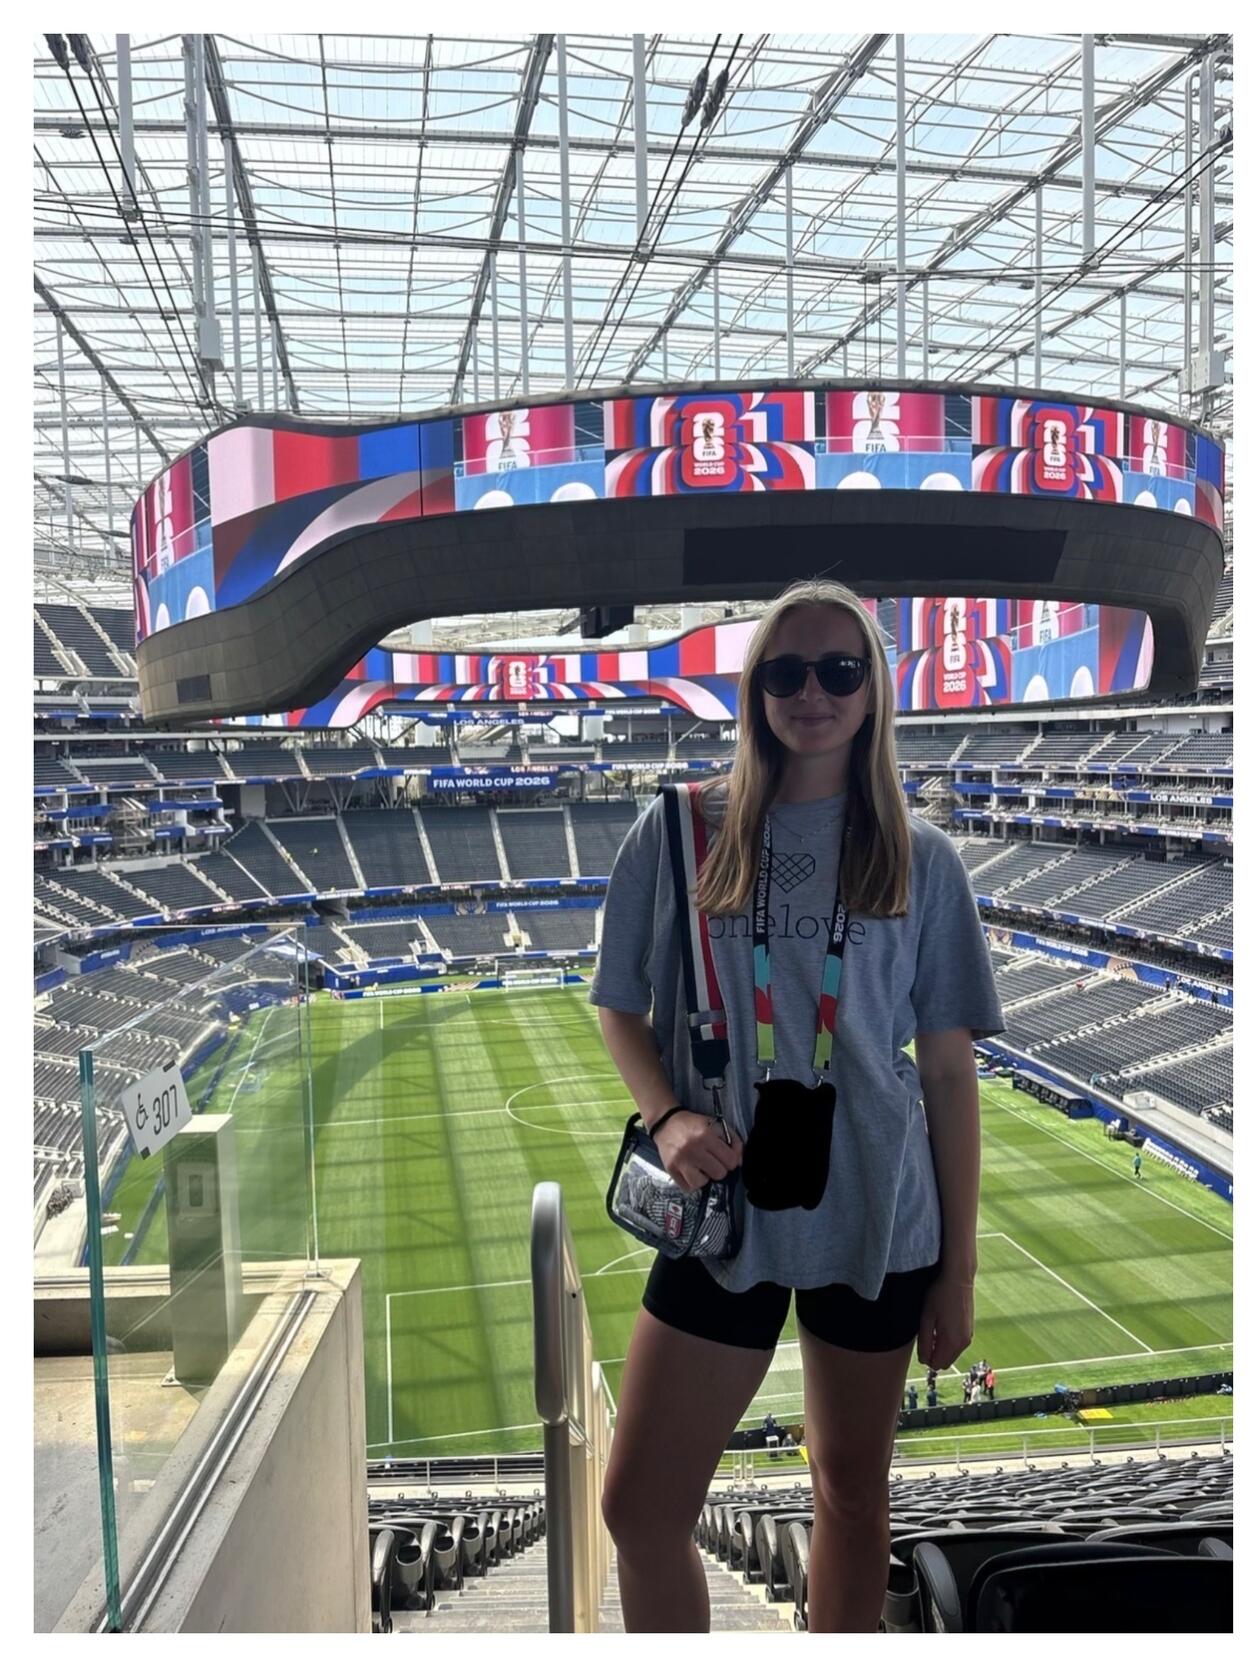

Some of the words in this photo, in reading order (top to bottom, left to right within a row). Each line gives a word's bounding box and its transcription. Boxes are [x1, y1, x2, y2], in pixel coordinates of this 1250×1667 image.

[693, 467, 725, 475] 2026
[433, 779, 455, 788] FIFA
[456, 779, 491, 788] WORLD
[494, 778, 514, 787] CUP
[515, 777, 550, 786] 2026
[757, 868, 768, 909] WORLD
[756, 909, 766, 934] FIFA
[833, 903, 847, 943] 2026
[152, 1084, 178, 1136] 307
